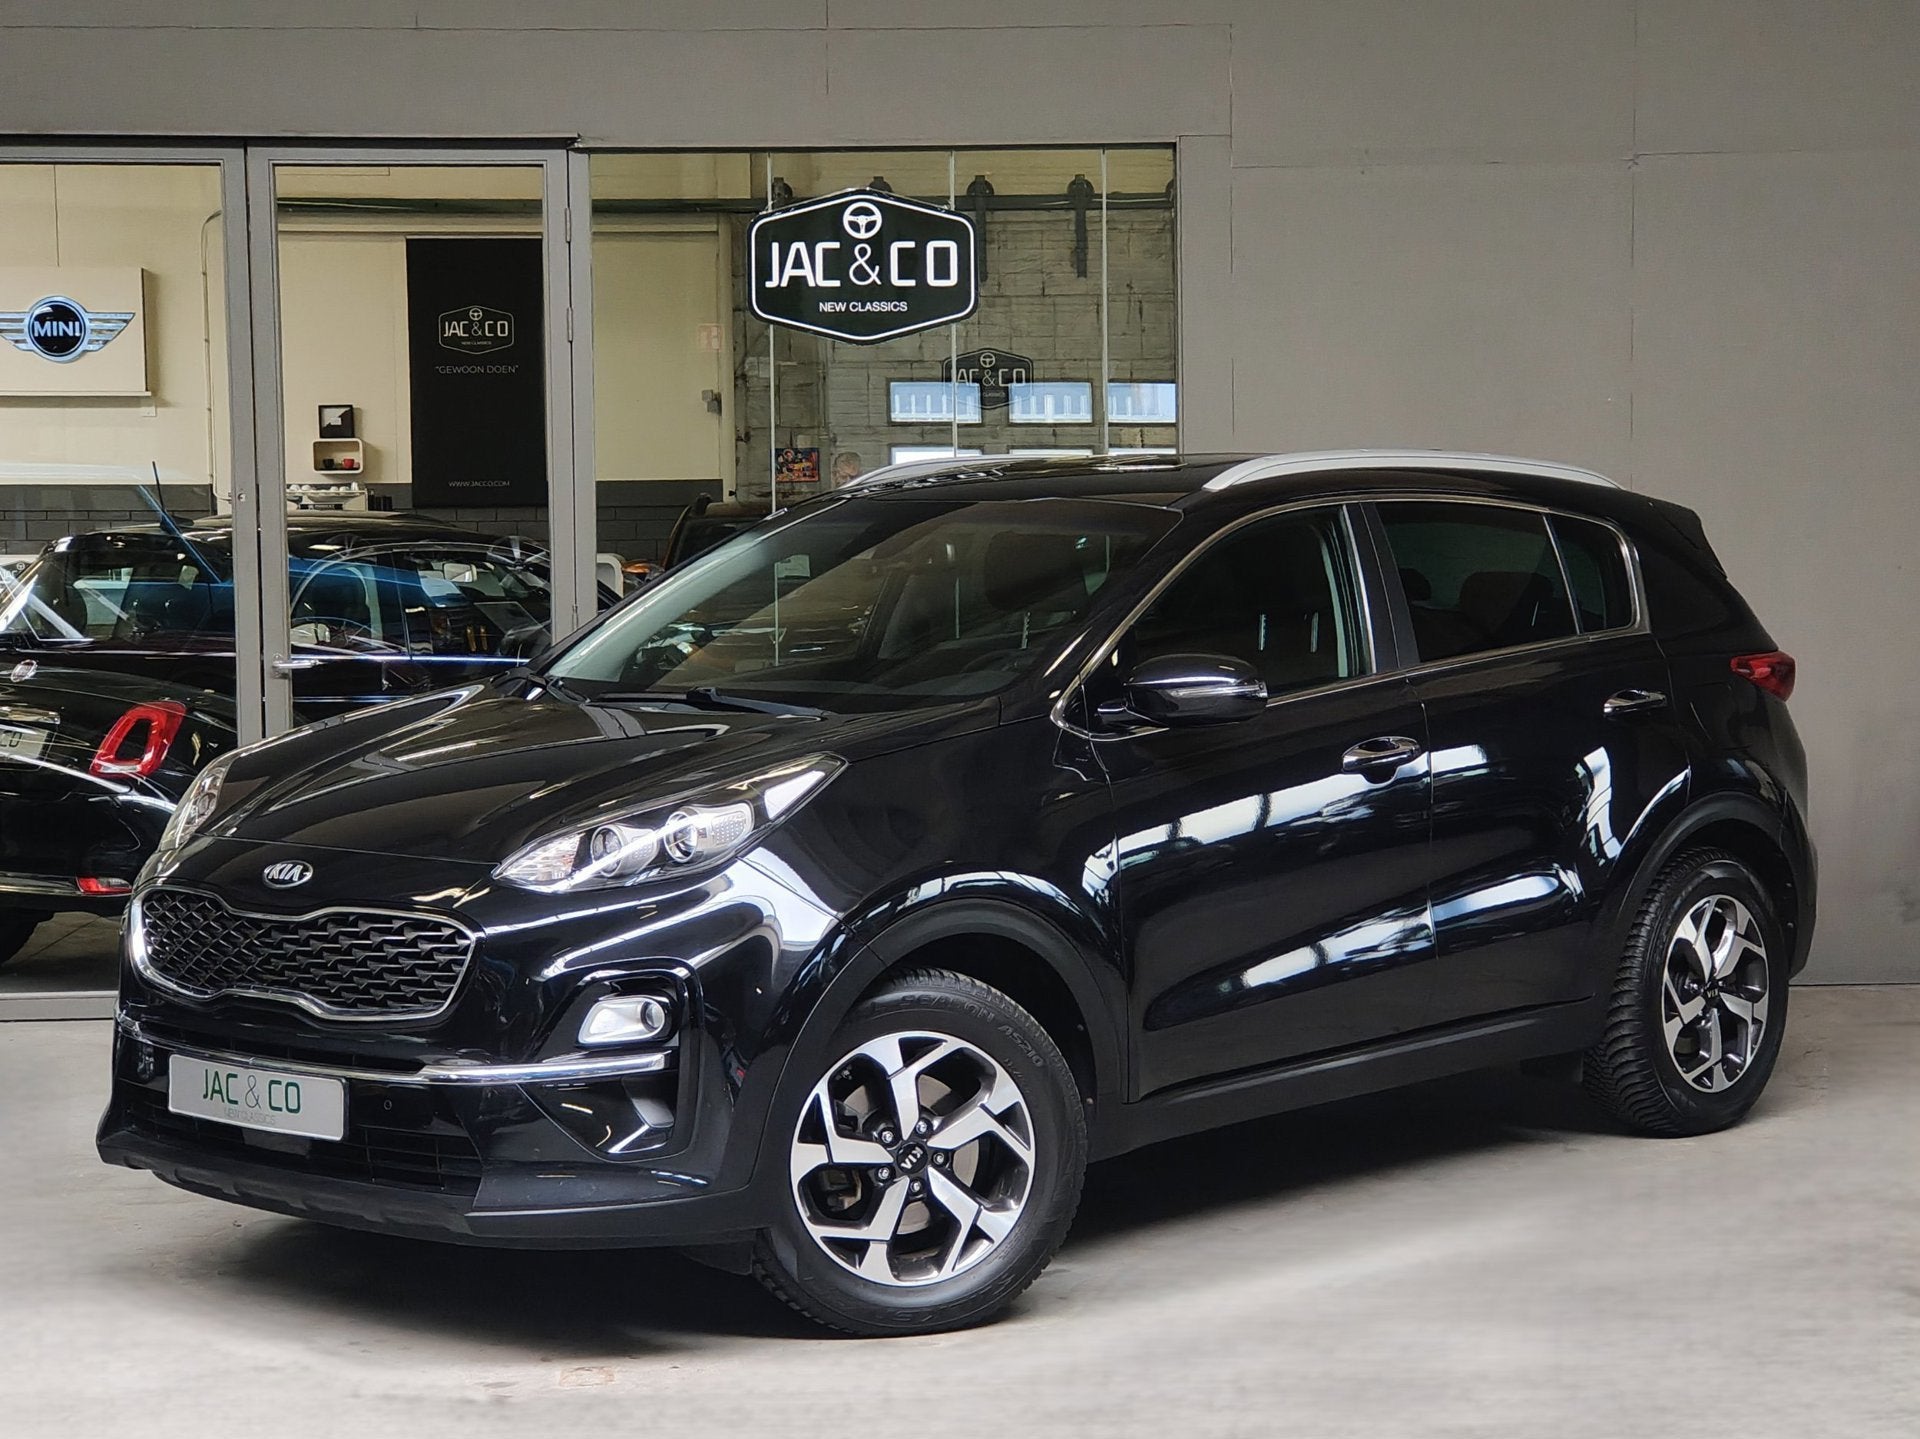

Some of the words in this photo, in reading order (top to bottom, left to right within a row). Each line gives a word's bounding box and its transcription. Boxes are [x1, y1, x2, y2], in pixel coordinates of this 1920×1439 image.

[765, 241, 841, 288] JAC
[849, 243, 882, 286] &
[890, 240, 958, 287] CO
[819, 301, 846, 312] NEW
[849, 301, 908, 312] CLASSICS
[33, 320, 81, 337] MINI
[443, 320, 470, 337] JAC
[471, 321, 483, 336] &
[485, 320, 509, 337] CO
[265, 863, 305, 881] KIA
[202, 1068, 239, 1105] JAC
[244, 1074, 262, 1109] &
[268, 1079, 301, 1114] CO
[900, 1146, 924, 1169] KIA
